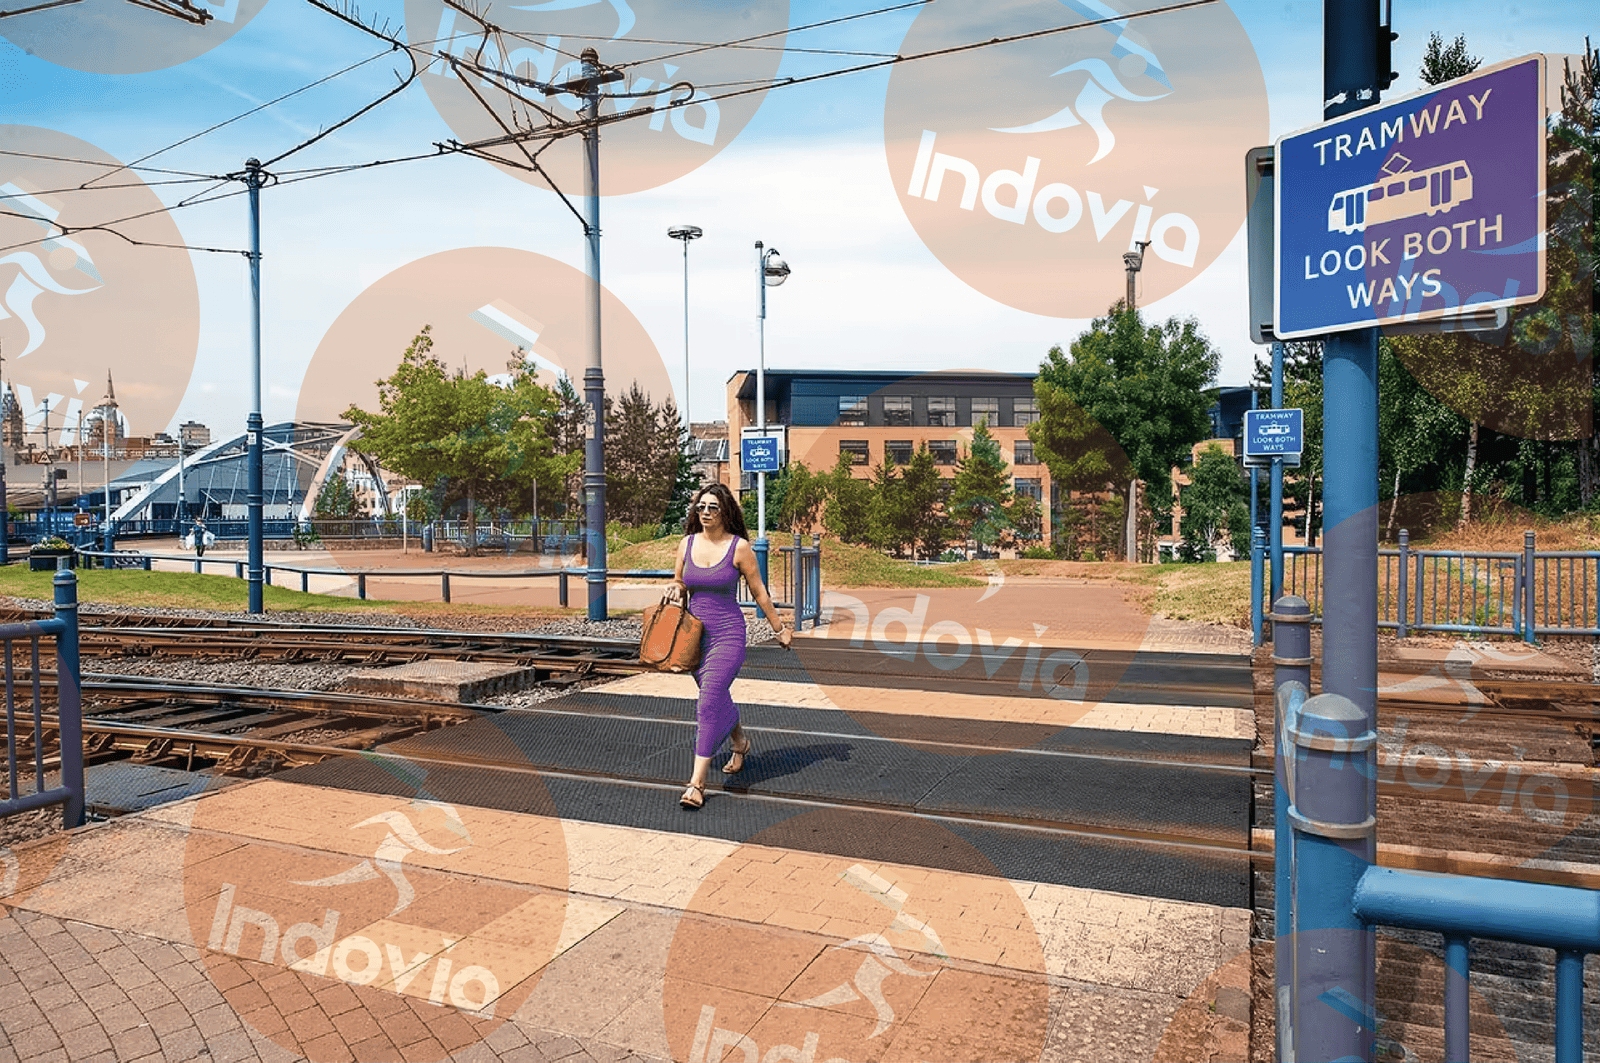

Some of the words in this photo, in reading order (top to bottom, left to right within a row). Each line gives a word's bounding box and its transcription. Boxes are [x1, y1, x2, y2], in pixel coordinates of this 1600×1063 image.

[1313, 89, 1492, 165] TRAMWAY
[1305, 238, 1391, 280] LOOK
[1404, 214, 1502, 260] BOTH
[1347, 269, 1441, 310] WAYS
[1256, 412, 1294, 420] TRAMWAY
[1263, 443, 1284, 451] WAYS
